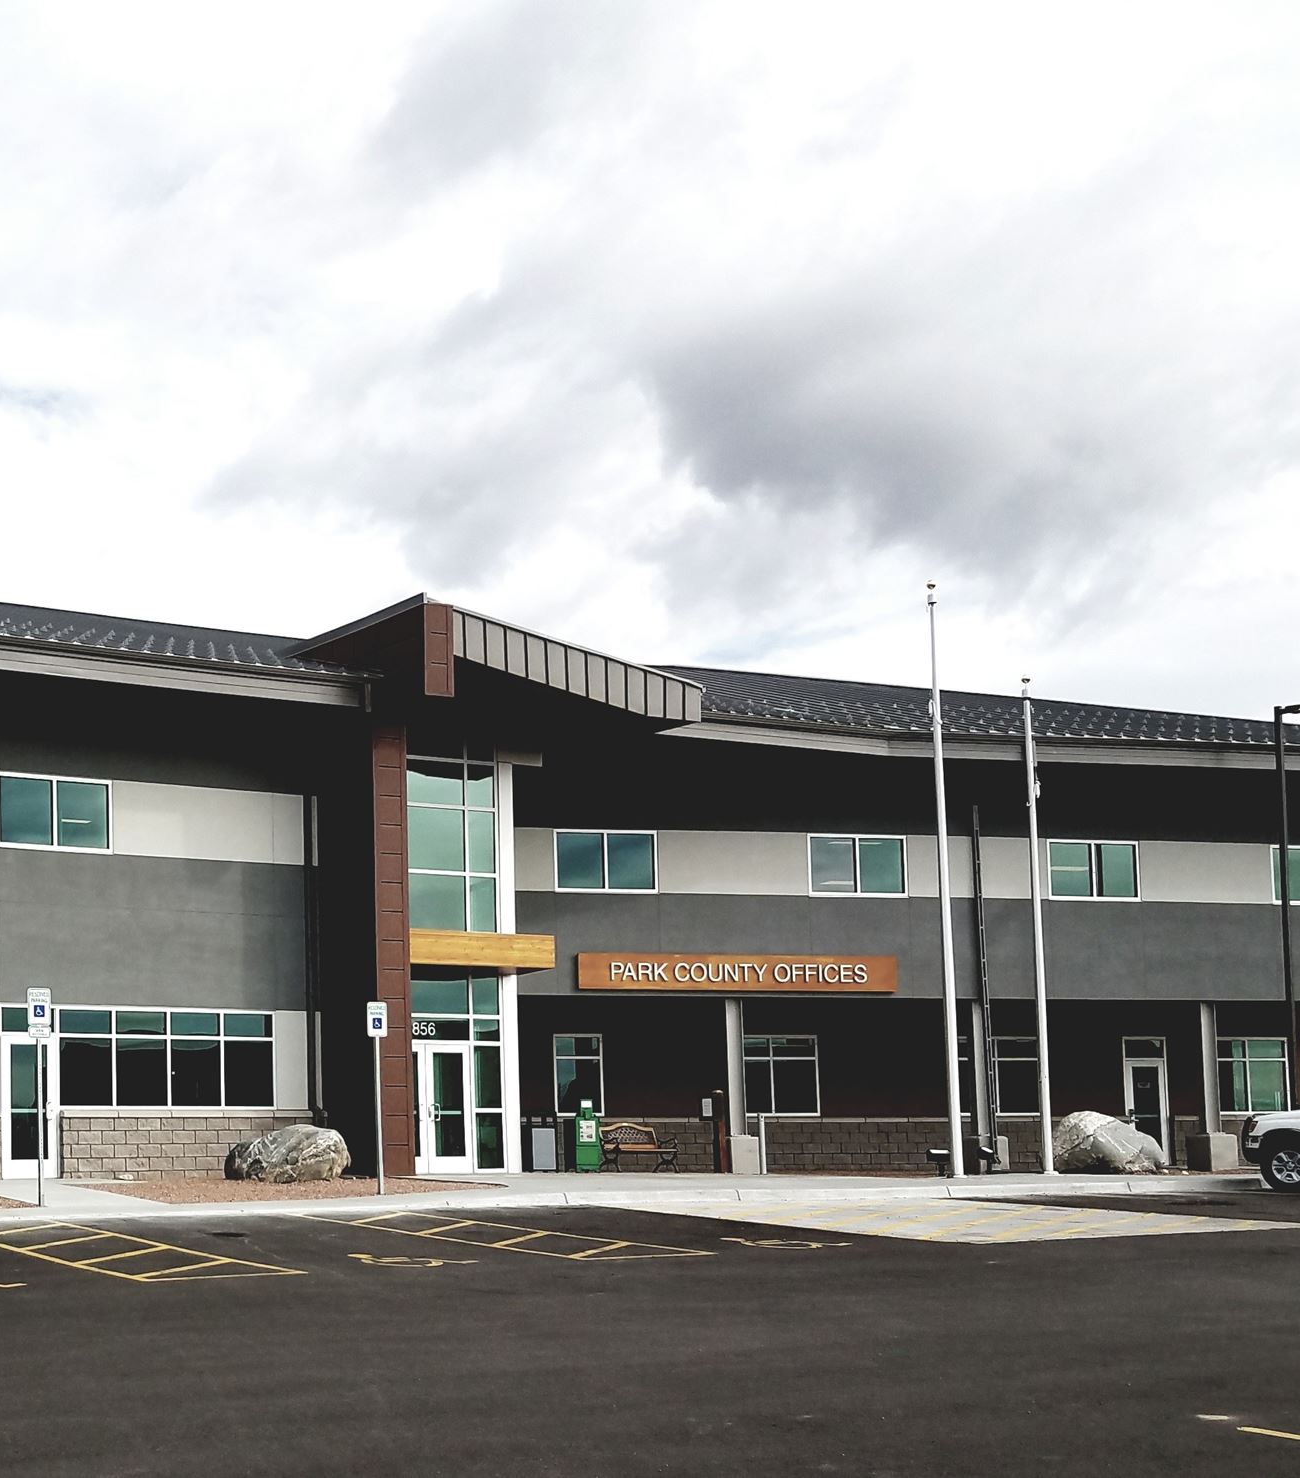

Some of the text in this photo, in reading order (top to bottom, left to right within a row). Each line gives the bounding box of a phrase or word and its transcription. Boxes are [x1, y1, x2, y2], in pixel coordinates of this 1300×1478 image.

[610, 962, 868, 984] PARK COUNTY OFFICES
[412, 1021, 436, 1036] 856
